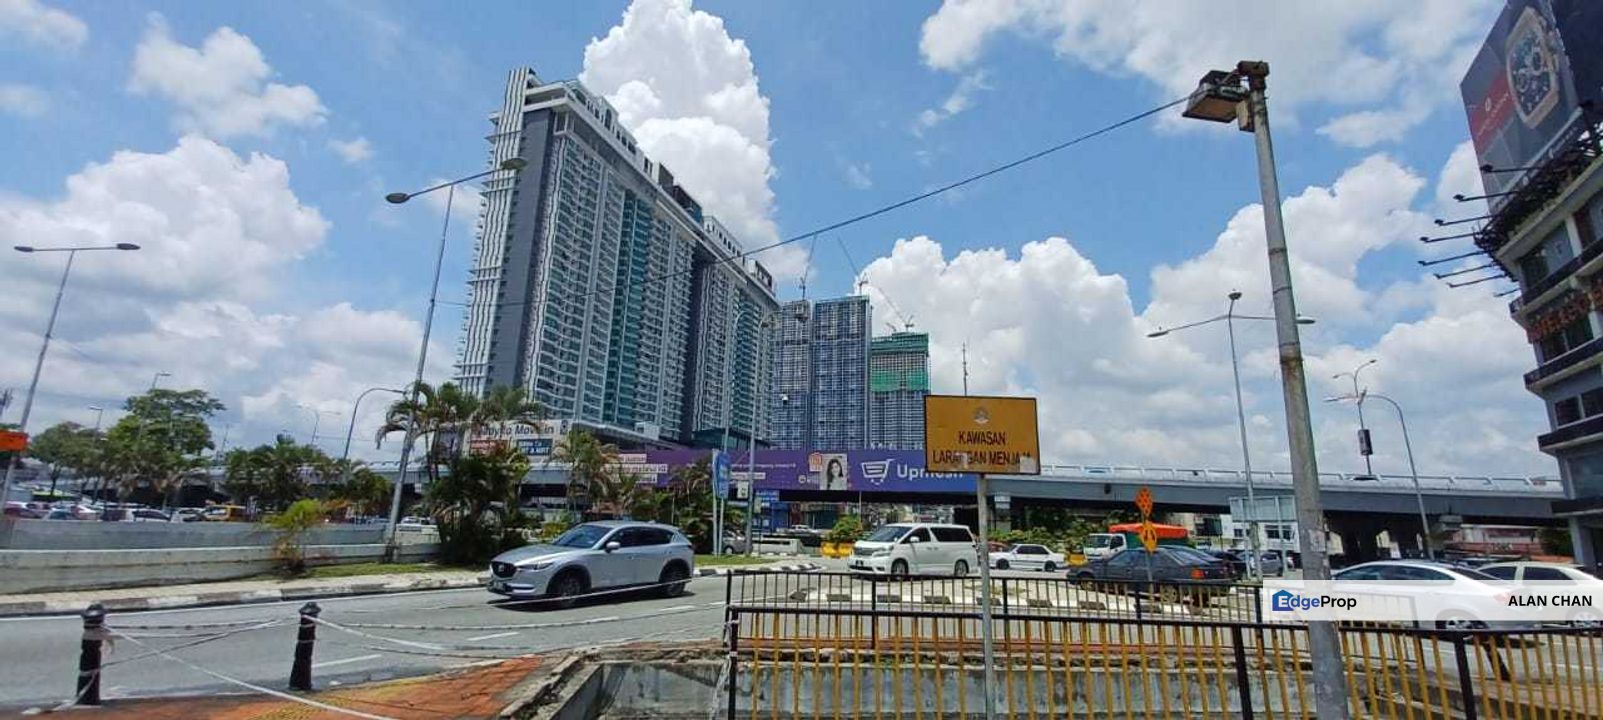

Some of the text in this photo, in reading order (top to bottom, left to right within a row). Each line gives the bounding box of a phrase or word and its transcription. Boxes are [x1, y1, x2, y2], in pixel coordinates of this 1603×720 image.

[958, 430, 1006, 446] KAWASAN
[932, 449, 1031, 466] LARAGAN MENJA
